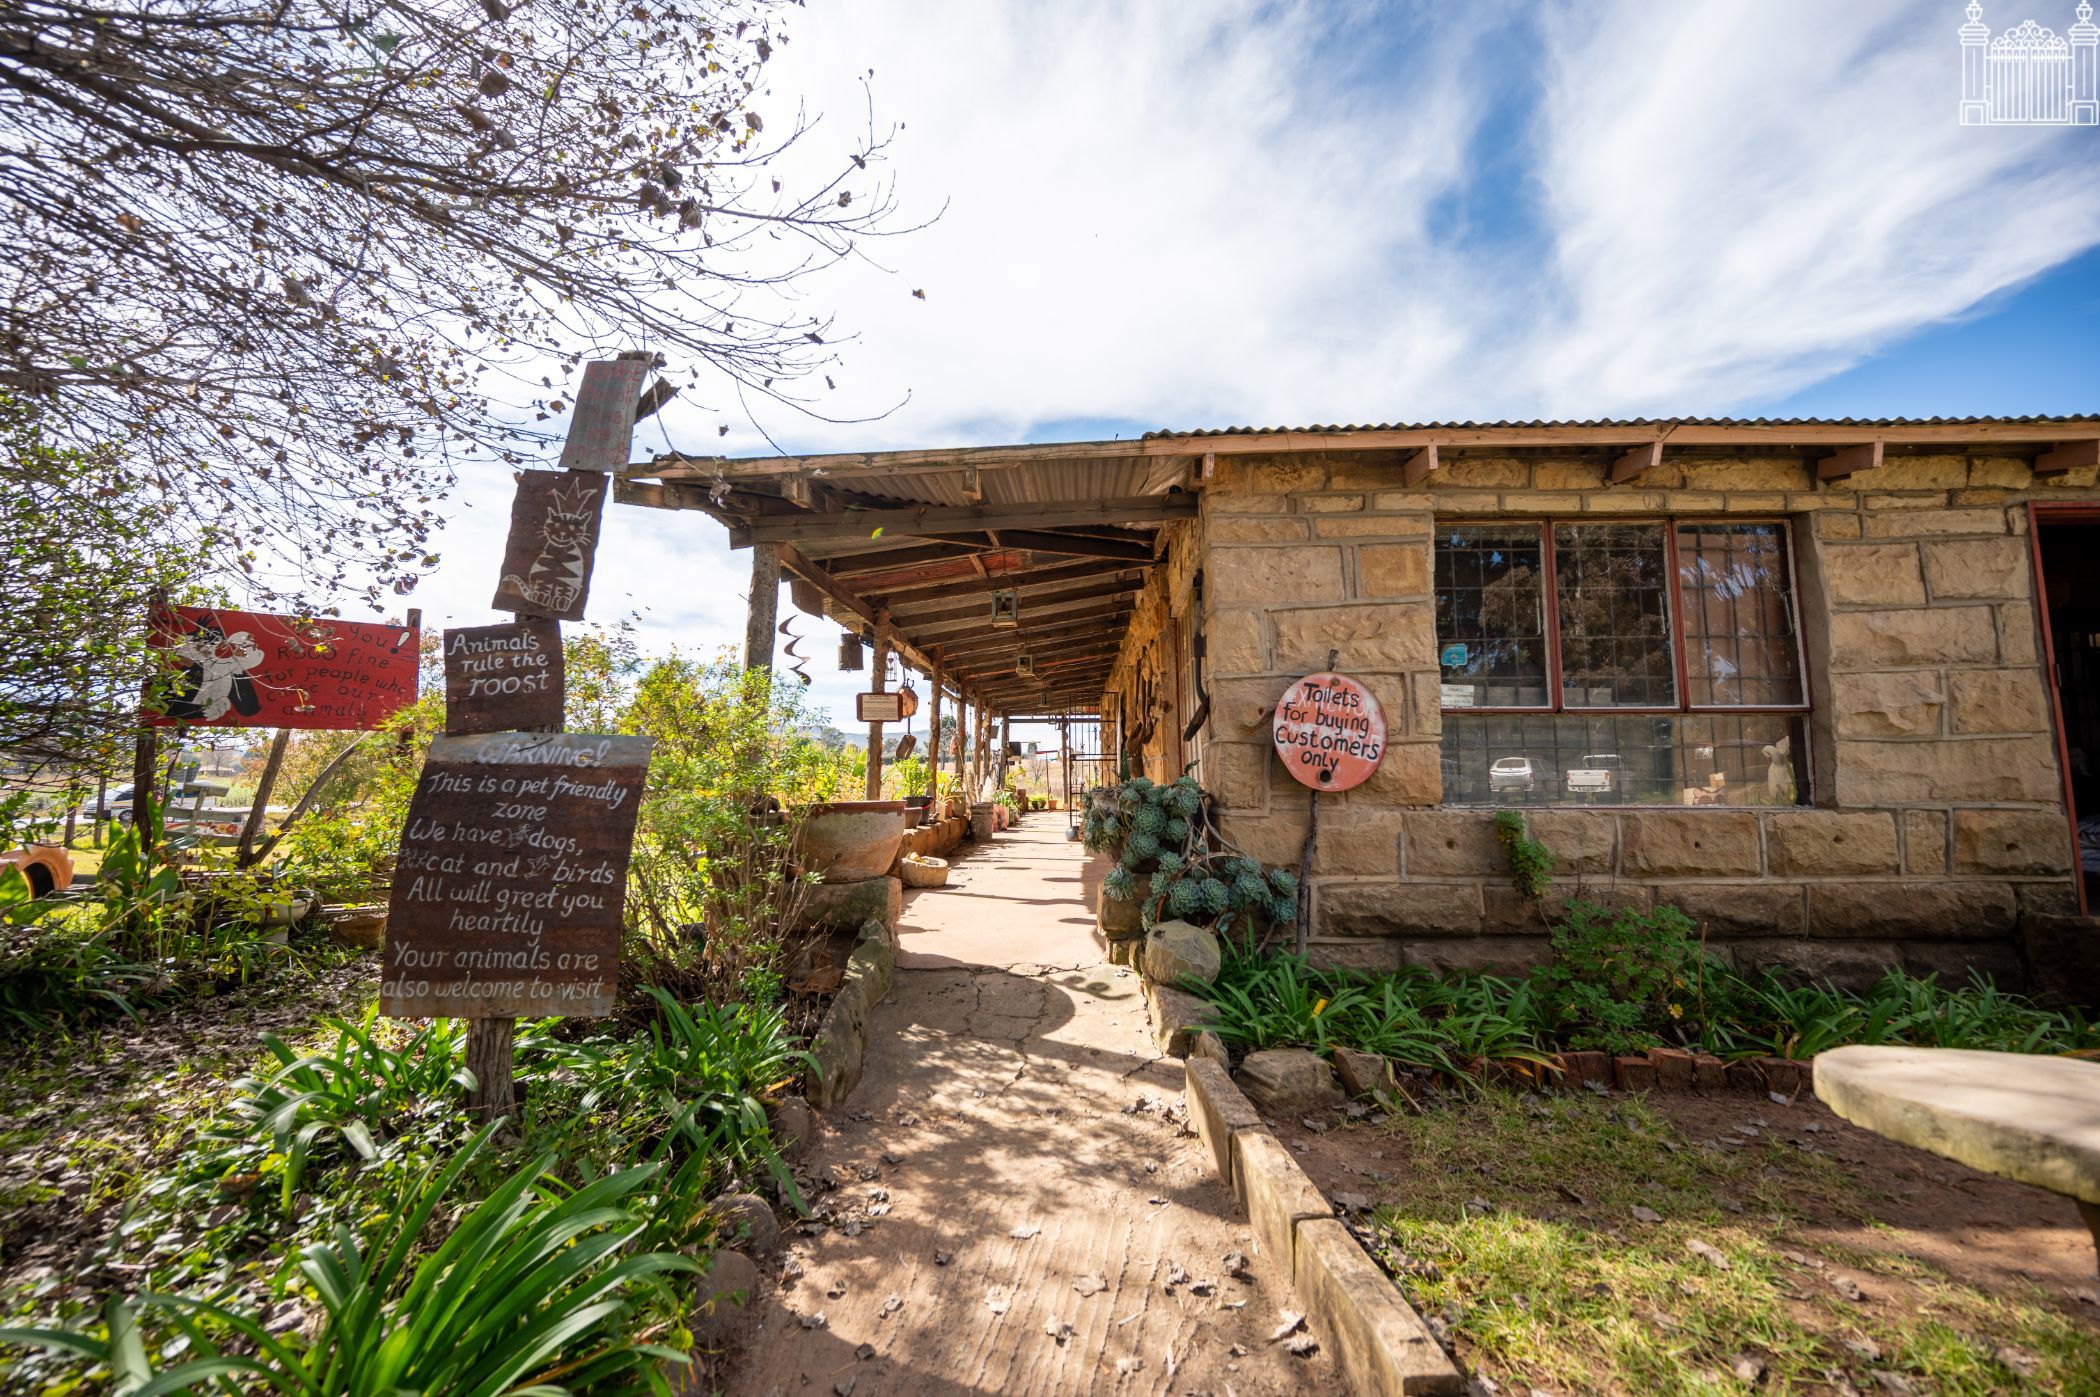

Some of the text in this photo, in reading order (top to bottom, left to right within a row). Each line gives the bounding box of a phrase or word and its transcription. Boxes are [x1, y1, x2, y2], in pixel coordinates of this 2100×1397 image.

[346, 647, 389, 669] fine
[447, 632, 540, 656] Animals
[461, 652, 549, 673] rule the
[263, 666, 407, 695] for people who
[337, 685, 377, 701] our
[468, 669, 550, 696] roost
[1303, 682, 1360, 707] Toilets
[282, 702, 367, 717] amals
[1283, 701, 1309, 723] for
[1315, 706, 1369, 739] buying
[477, 739, 611, 768] WARNING!
[1275, 725, 1380, 761] Customers
[427, 771, 628, 810] This is a pet friendly
[490, 802, 547, 822] zone
[409, 818, 583, 860] We have dogs,
[426, 853, 615, 885] cat and birds
[407, 876, 604, 918] All will greet you
[449, 909, 544, 947] heartily
[393, 941, 600, 971] Your animals are
[382, 971, 605, 1001] also welcome to visit
